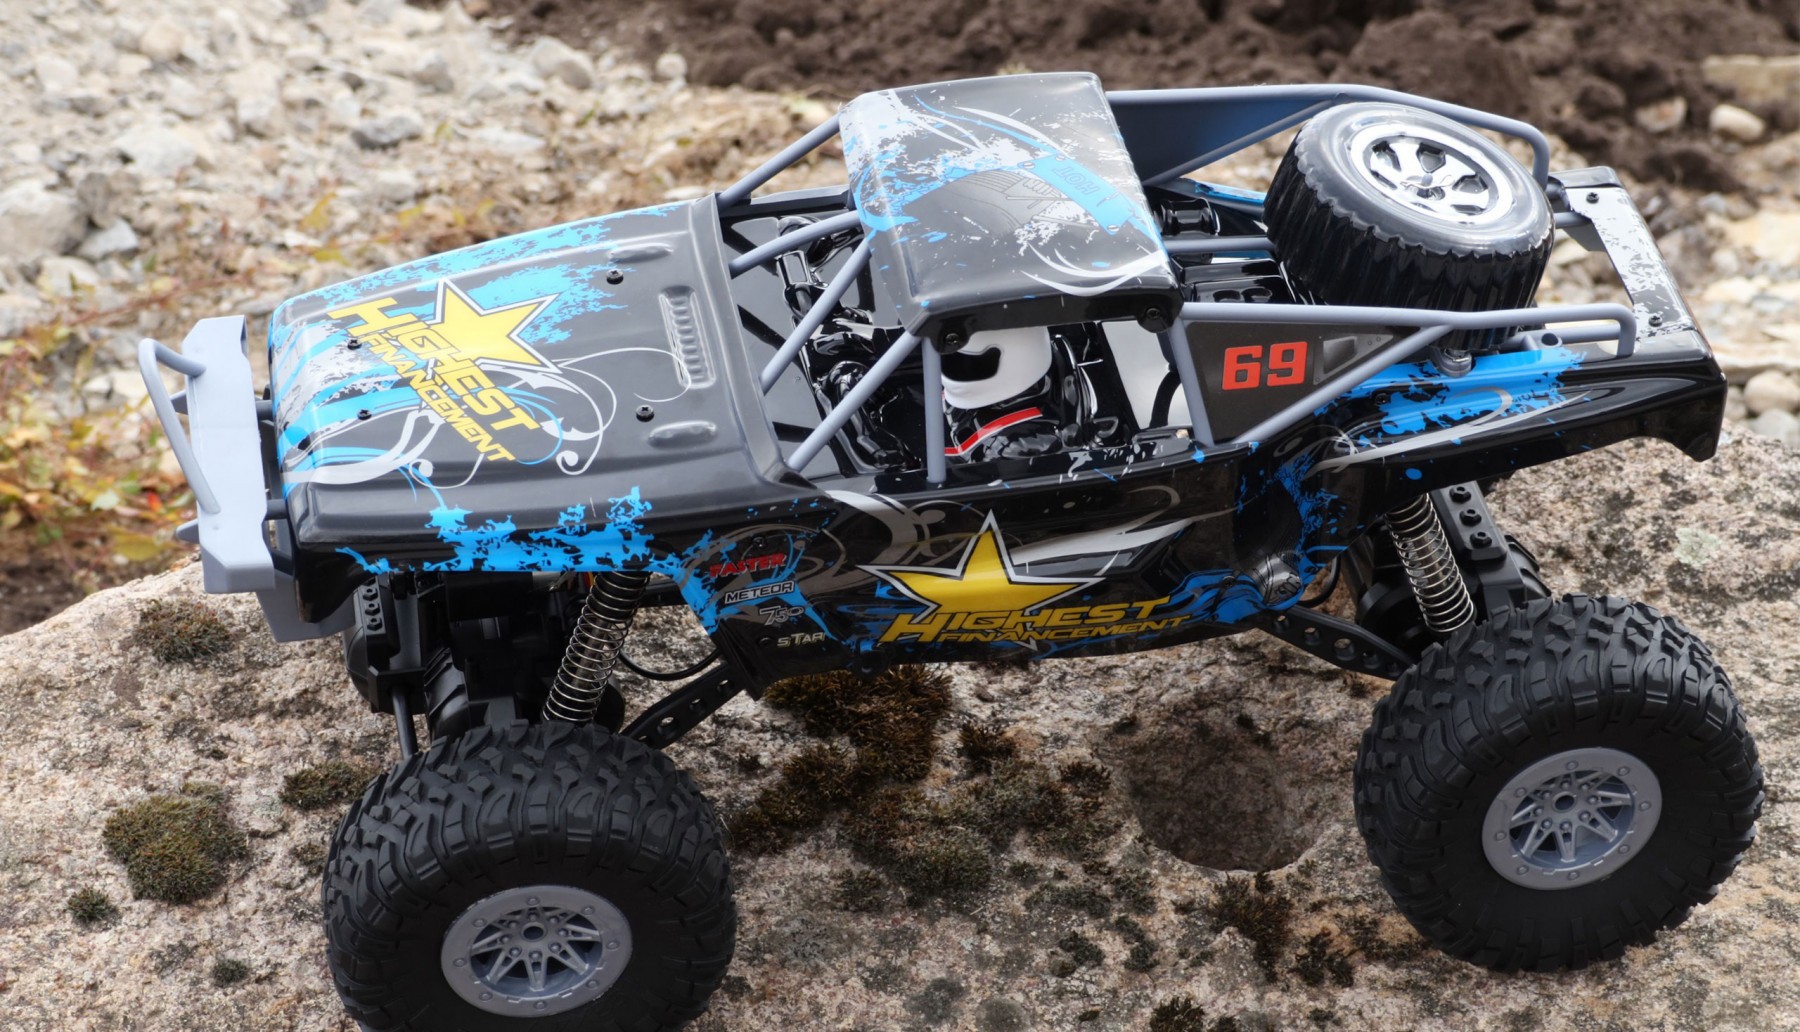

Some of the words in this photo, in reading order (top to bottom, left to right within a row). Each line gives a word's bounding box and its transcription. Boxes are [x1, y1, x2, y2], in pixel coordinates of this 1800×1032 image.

[1051, 166, 1100, 195] HOT
[326, 296, 541, 431] HIGHEST
[1222, 341, 1308, 390] 69
[359, 333, 516, 461] FINANCEMENT
[709, 553, 787, 578] FASTER
[725, 581, 795, 604] METEOR
[759, 605, 805, 626] 750
[878, 595, 1171, 643] HIGHEST
[937, 615, 1202, 642] FINANCEMENT
